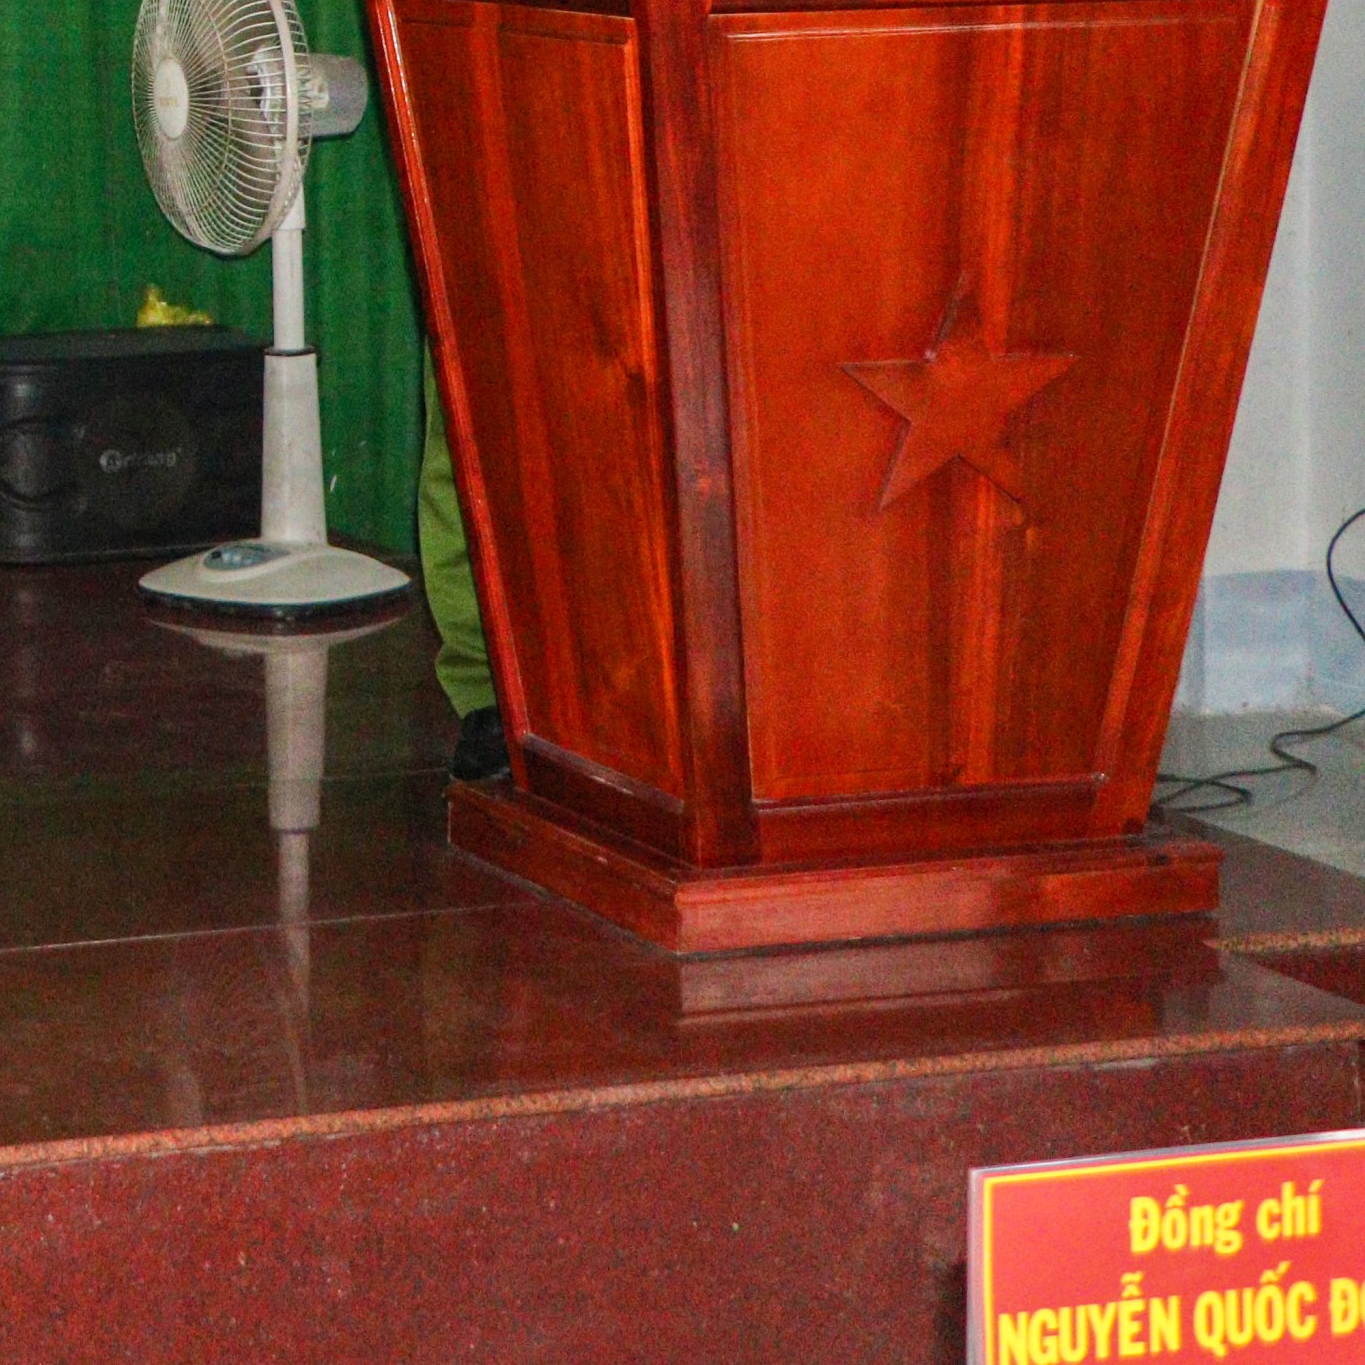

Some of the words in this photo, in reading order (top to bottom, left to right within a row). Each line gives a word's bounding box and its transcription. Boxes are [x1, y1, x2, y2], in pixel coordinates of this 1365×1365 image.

[1129, 1183, 1243, 1254] Đồng
[1256, 1179, 1323, 1241] chí
[997, 1271, 1181, 1365] NGUYỄN
[1193, 1260, 1317, 1358] QUỐC
